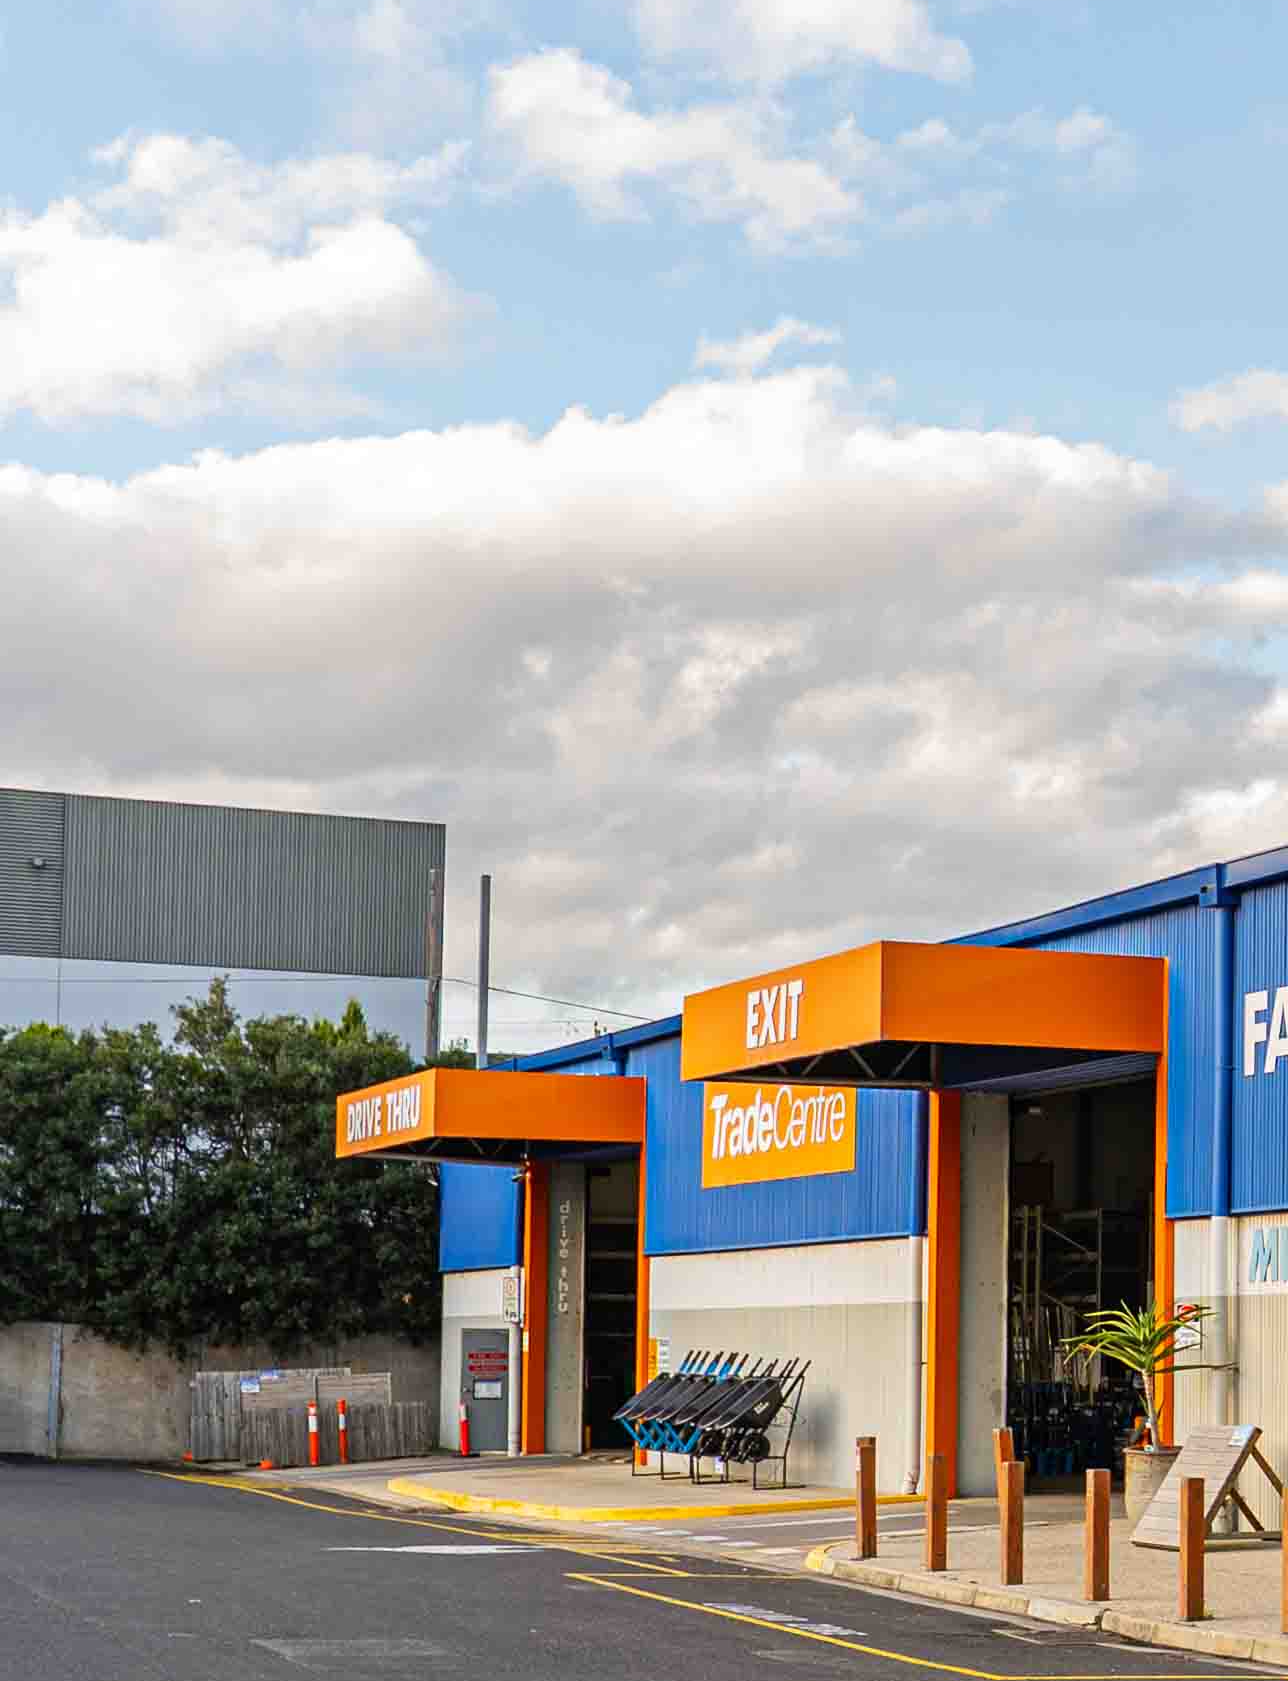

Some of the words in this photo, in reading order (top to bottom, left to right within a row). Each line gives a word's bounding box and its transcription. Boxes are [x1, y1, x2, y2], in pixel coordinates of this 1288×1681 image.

[746, 978, 804, 1049] EXIT
[347, 1096, 382, 1143] DRIVE
[386, 1084, 421, 1134] THRU
[710, 1086, 846, 1161] TradeCentre
[559, 1199, 570, 1258] drive
